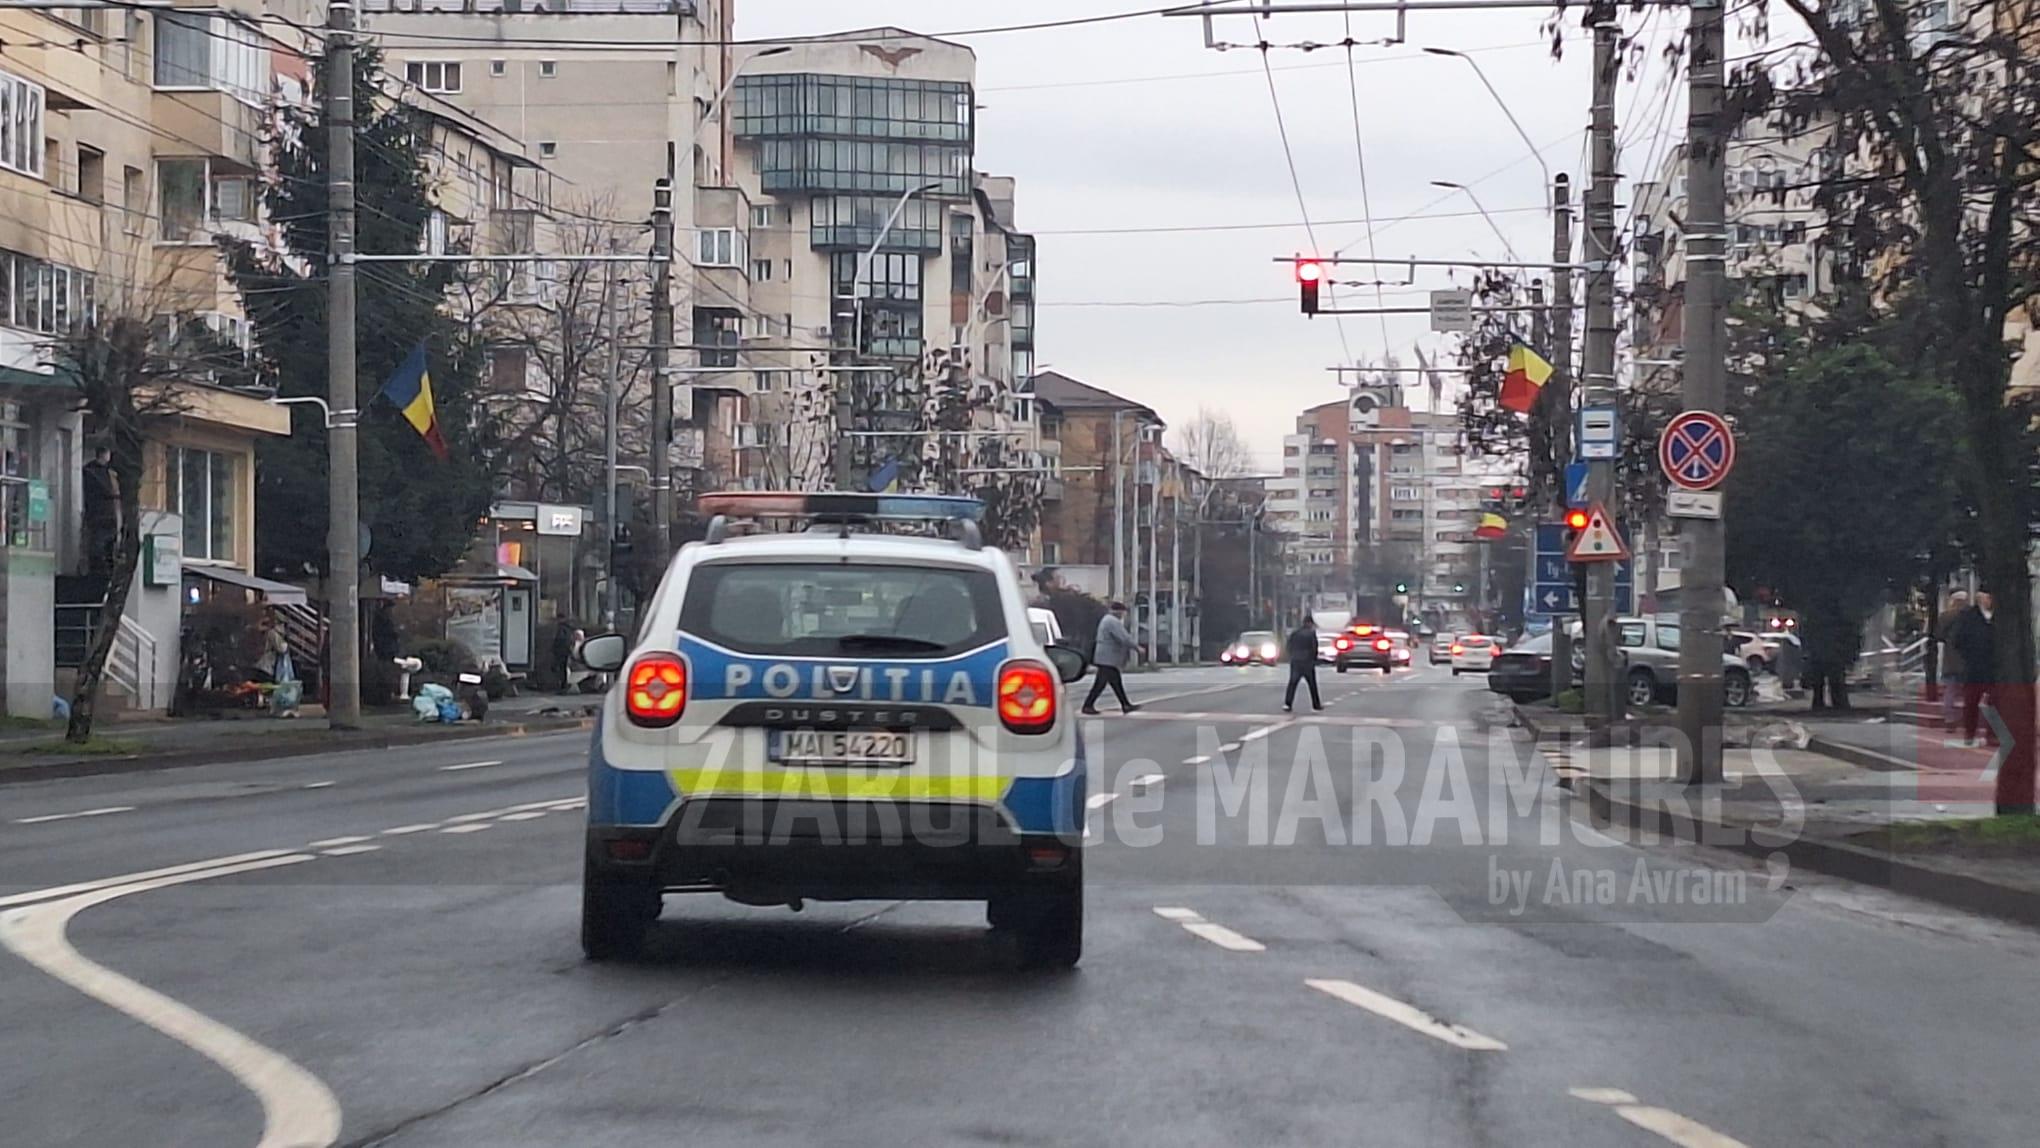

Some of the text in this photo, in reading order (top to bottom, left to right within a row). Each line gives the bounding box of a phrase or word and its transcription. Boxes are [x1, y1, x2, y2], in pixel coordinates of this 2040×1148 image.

[765, 709, 917, 722] DUSTER
[786, 733, 906, 758] MAI 54220
